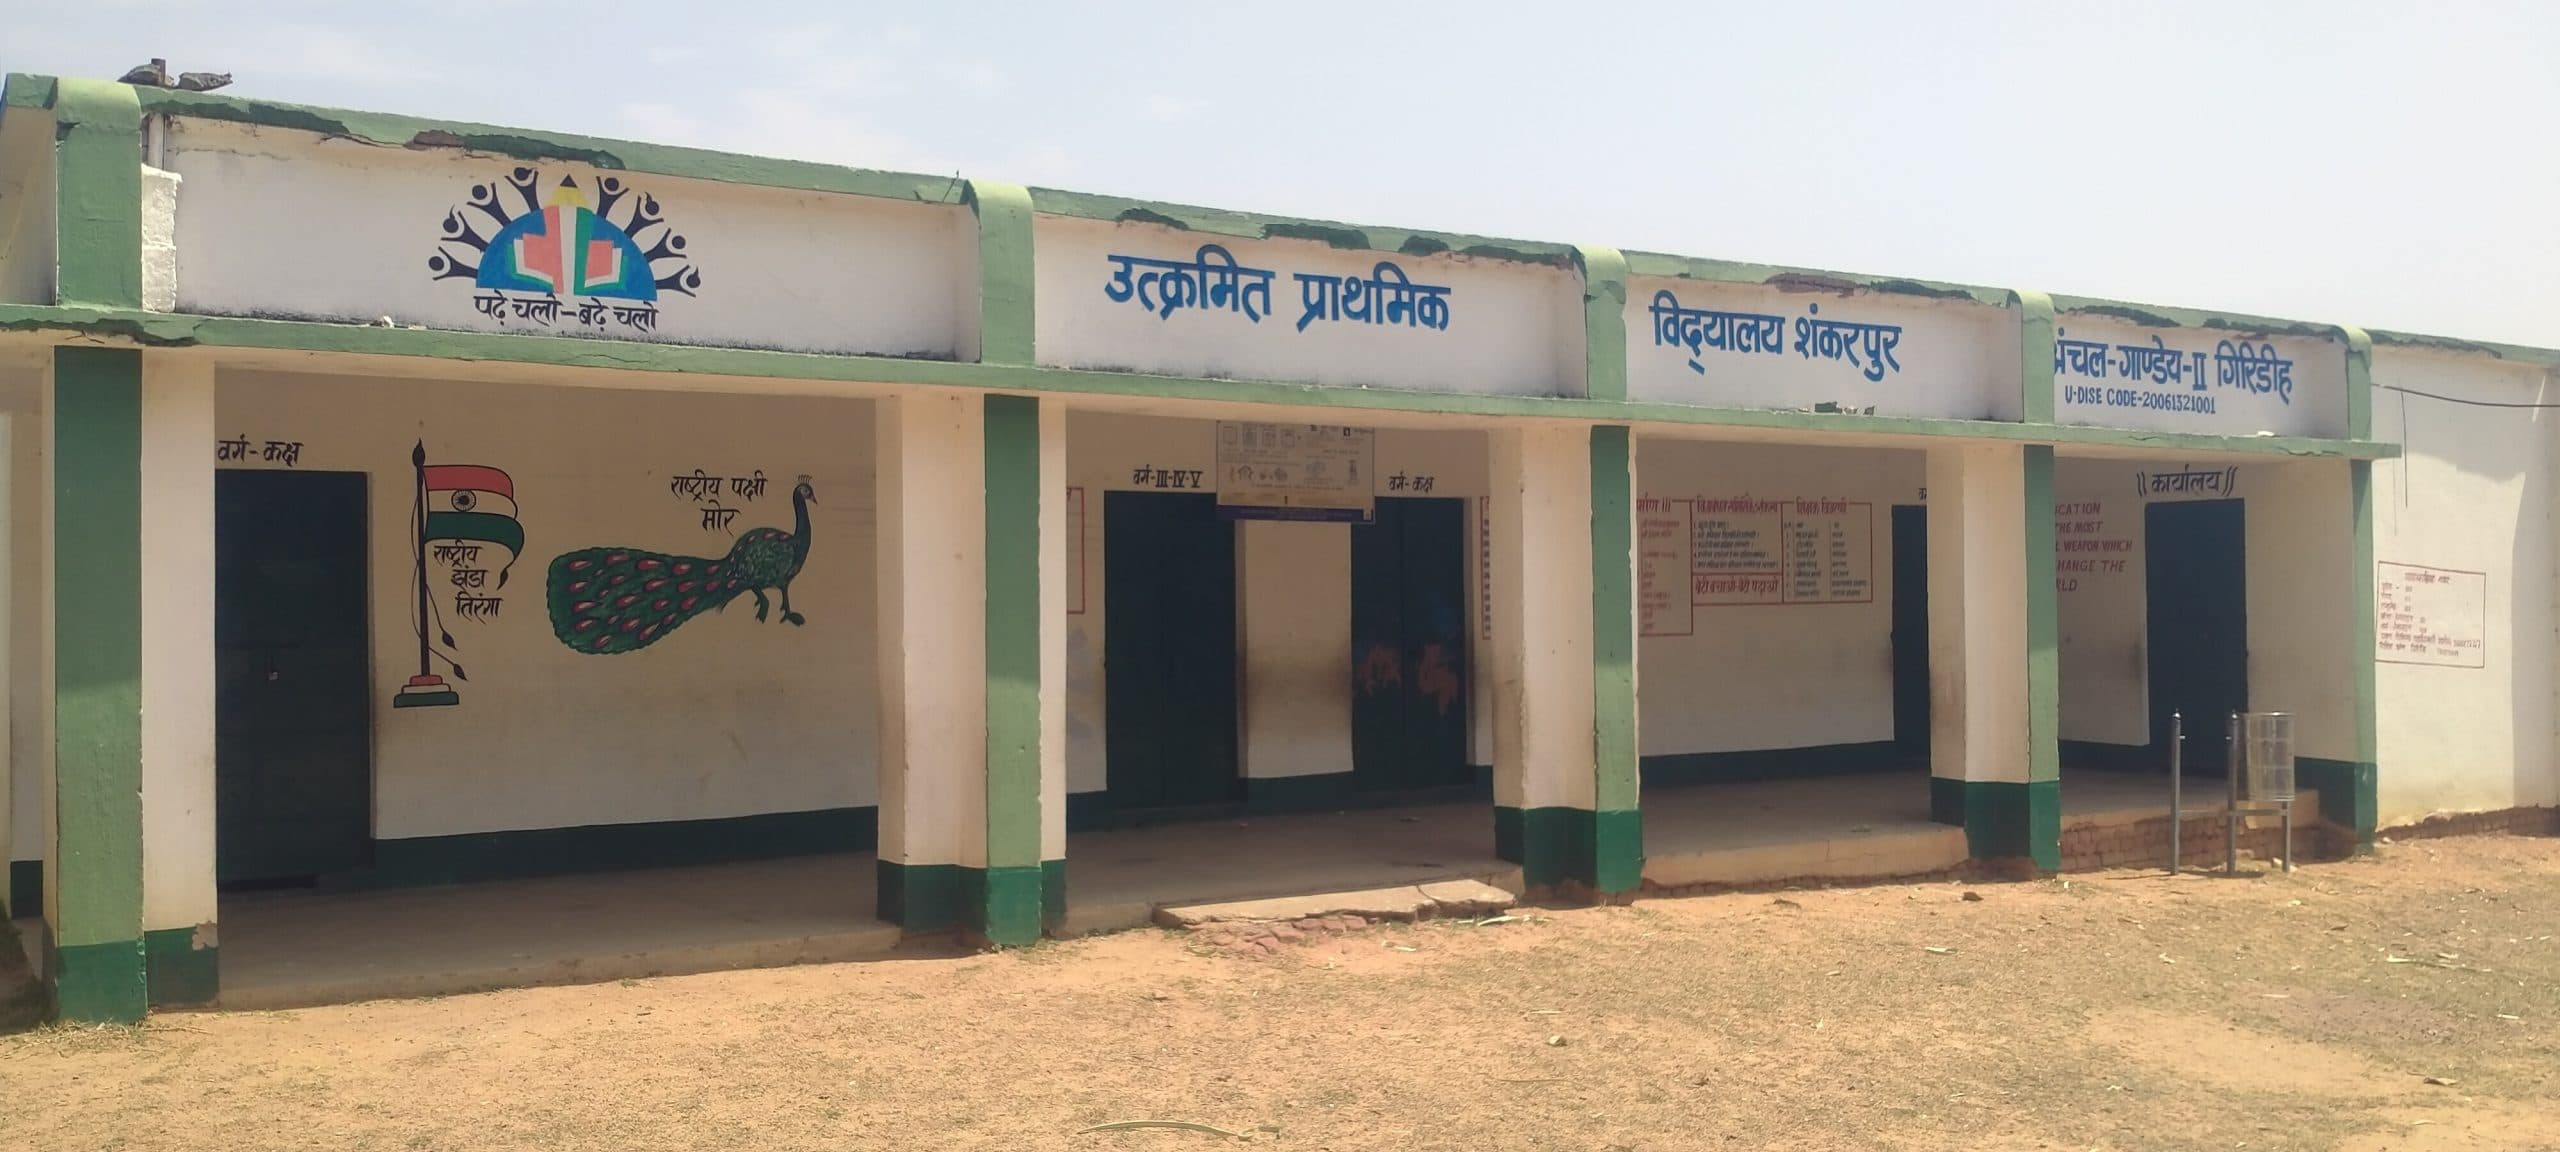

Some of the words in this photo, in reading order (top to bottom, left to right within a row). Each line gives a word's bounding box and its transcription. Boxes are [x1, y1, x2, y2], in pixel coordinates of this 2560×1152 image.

[1105, 243, 1277, 325] उत्क्रमित
[1293, 261, 1452, 334] प्राथमिक
[613, 300, 660, 332] चलो
[1794, 302, 1903, 383] शंकरपुर
[2214, 339, 2294, 406] गिरिडीह
[263, 440, 305, 467] कक्ष
[671, 468, 724, 501] राष्ट्रीय
[731, 470, 768, 502] पक्षी
[2151, 463, 2224, 493] कार्यालय
[700, 500, 741, 537] मोर
[2055, 502, 2102, 515] CATION
[2074, 520, 2104, 533] MOST
[433, 539, 485, 568] राष्ट्रीय
[2056, 560, 2096, 572] HANGE
[2100, 560, 2127, 573] THE
[450, 564, 488, 593] झंडा
[455, 591, 504, 626] तिरंगा
